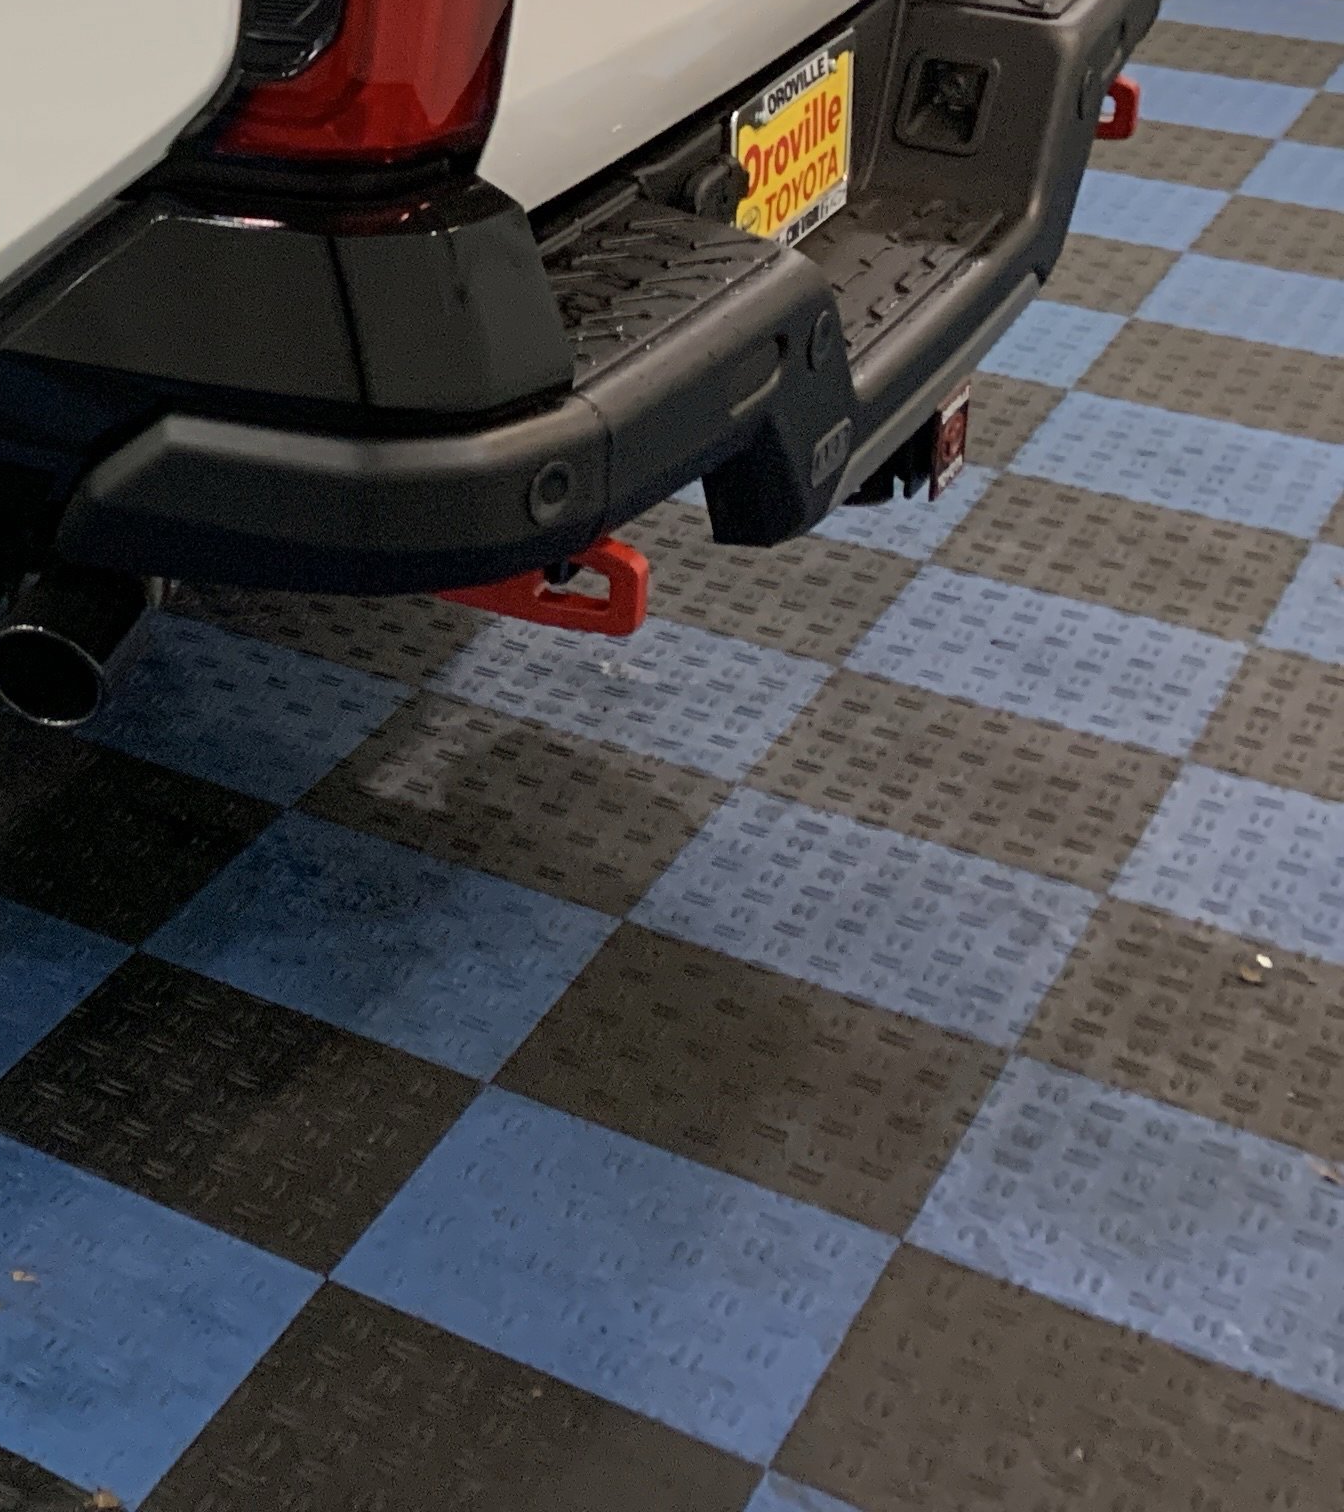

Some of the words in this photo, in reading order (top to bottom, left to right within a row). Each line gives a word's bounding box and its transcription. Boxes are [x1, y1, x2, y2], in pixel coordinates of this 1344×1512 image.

[767, 56, 827, 115] OROVILLE
[743, 91, 842, 199] Oroville
[765, 146, 839, 232] TOYOTA
